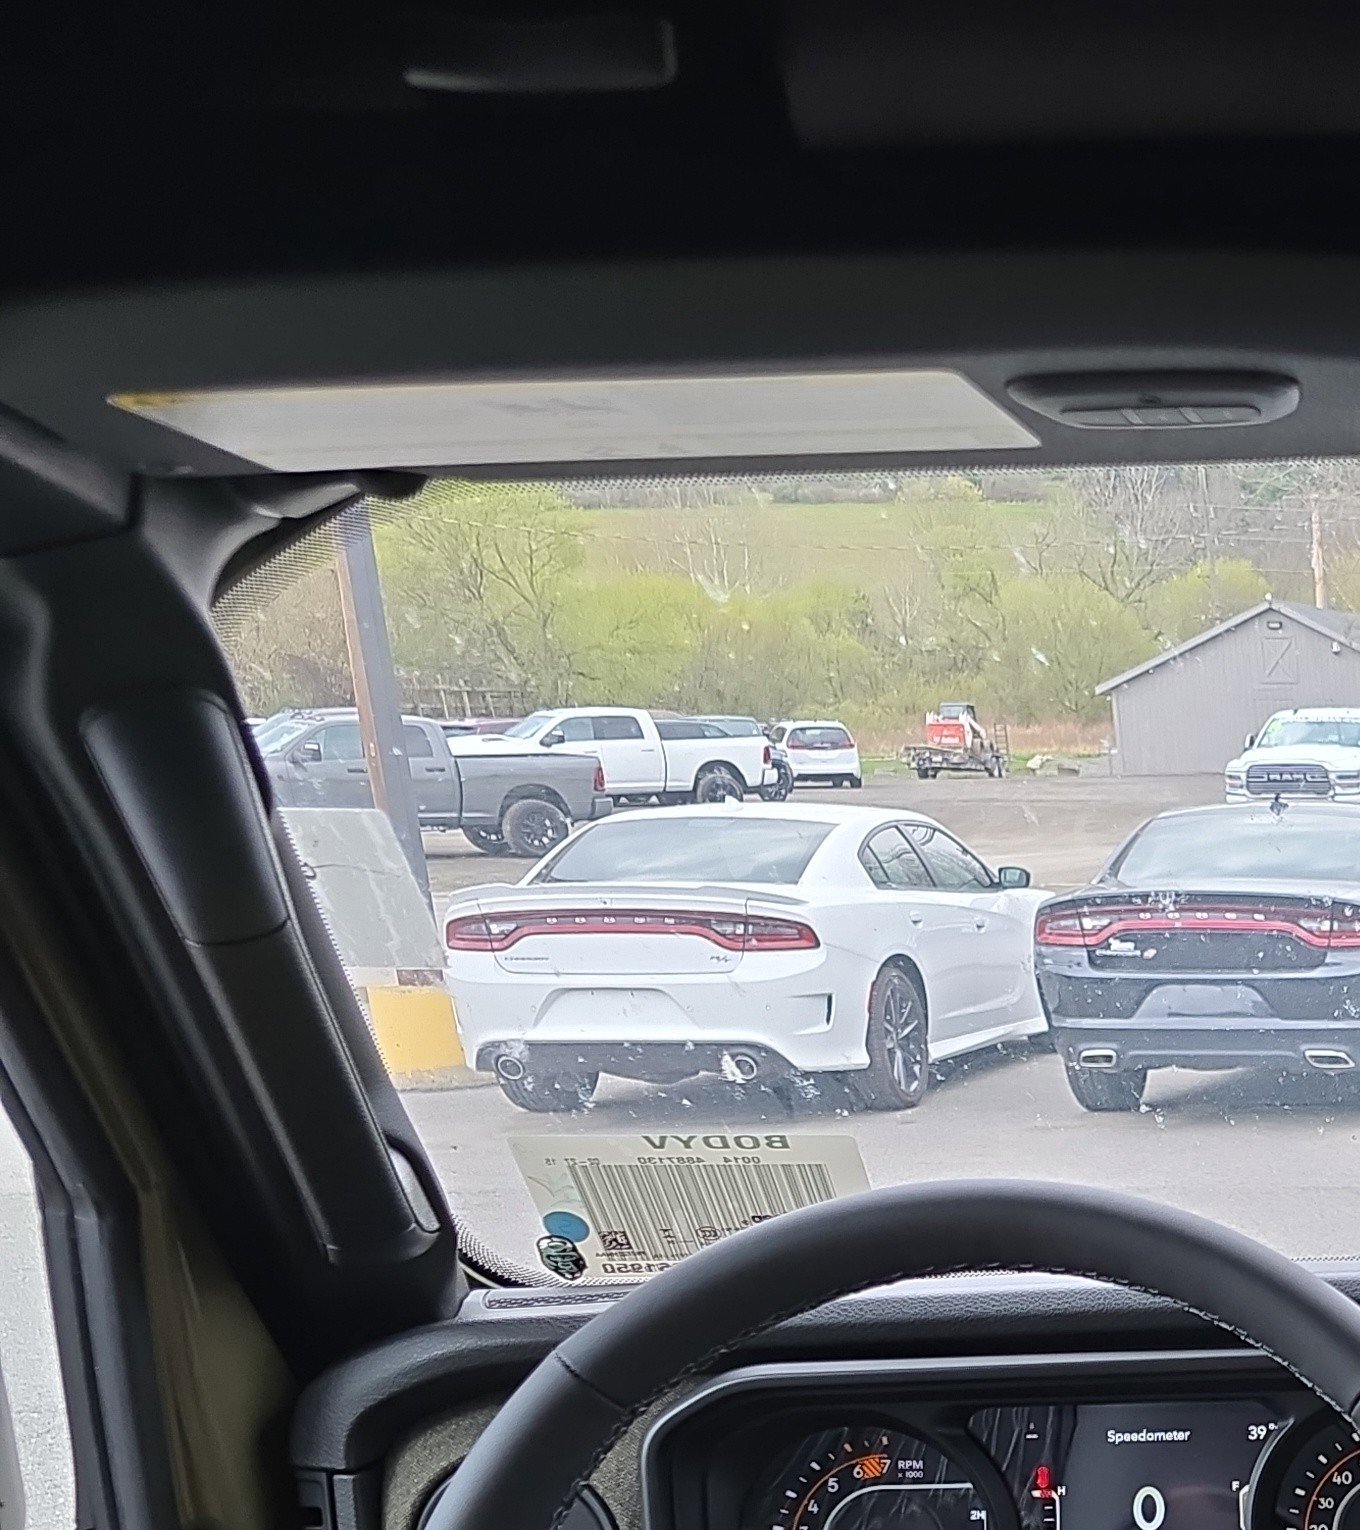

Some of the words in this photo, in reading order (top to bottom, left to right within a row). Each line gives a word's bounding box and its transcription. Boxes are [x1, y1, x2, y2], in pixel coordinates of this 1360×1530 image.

[1107, 1429, 1190, 1444] Speedometer
[882, 1459, 892, 1474] 7
[898, 1460, 923, 1470] RPM
[853, 1464, 864, 1479] 6
[905, 1470, 924, 1479] 1000
[1332, 1471, 1353, 1485] 40
[827, 1478, 839, 1493] 5
[1057, 1485, 1067, 1496] H
[1231, 1480, 1241, 1492] F
[807, 1501, 819, 1514] 4
[1318, 1497, 1335, 1509] 30
[969, 1510, 987, 1520] 2H
